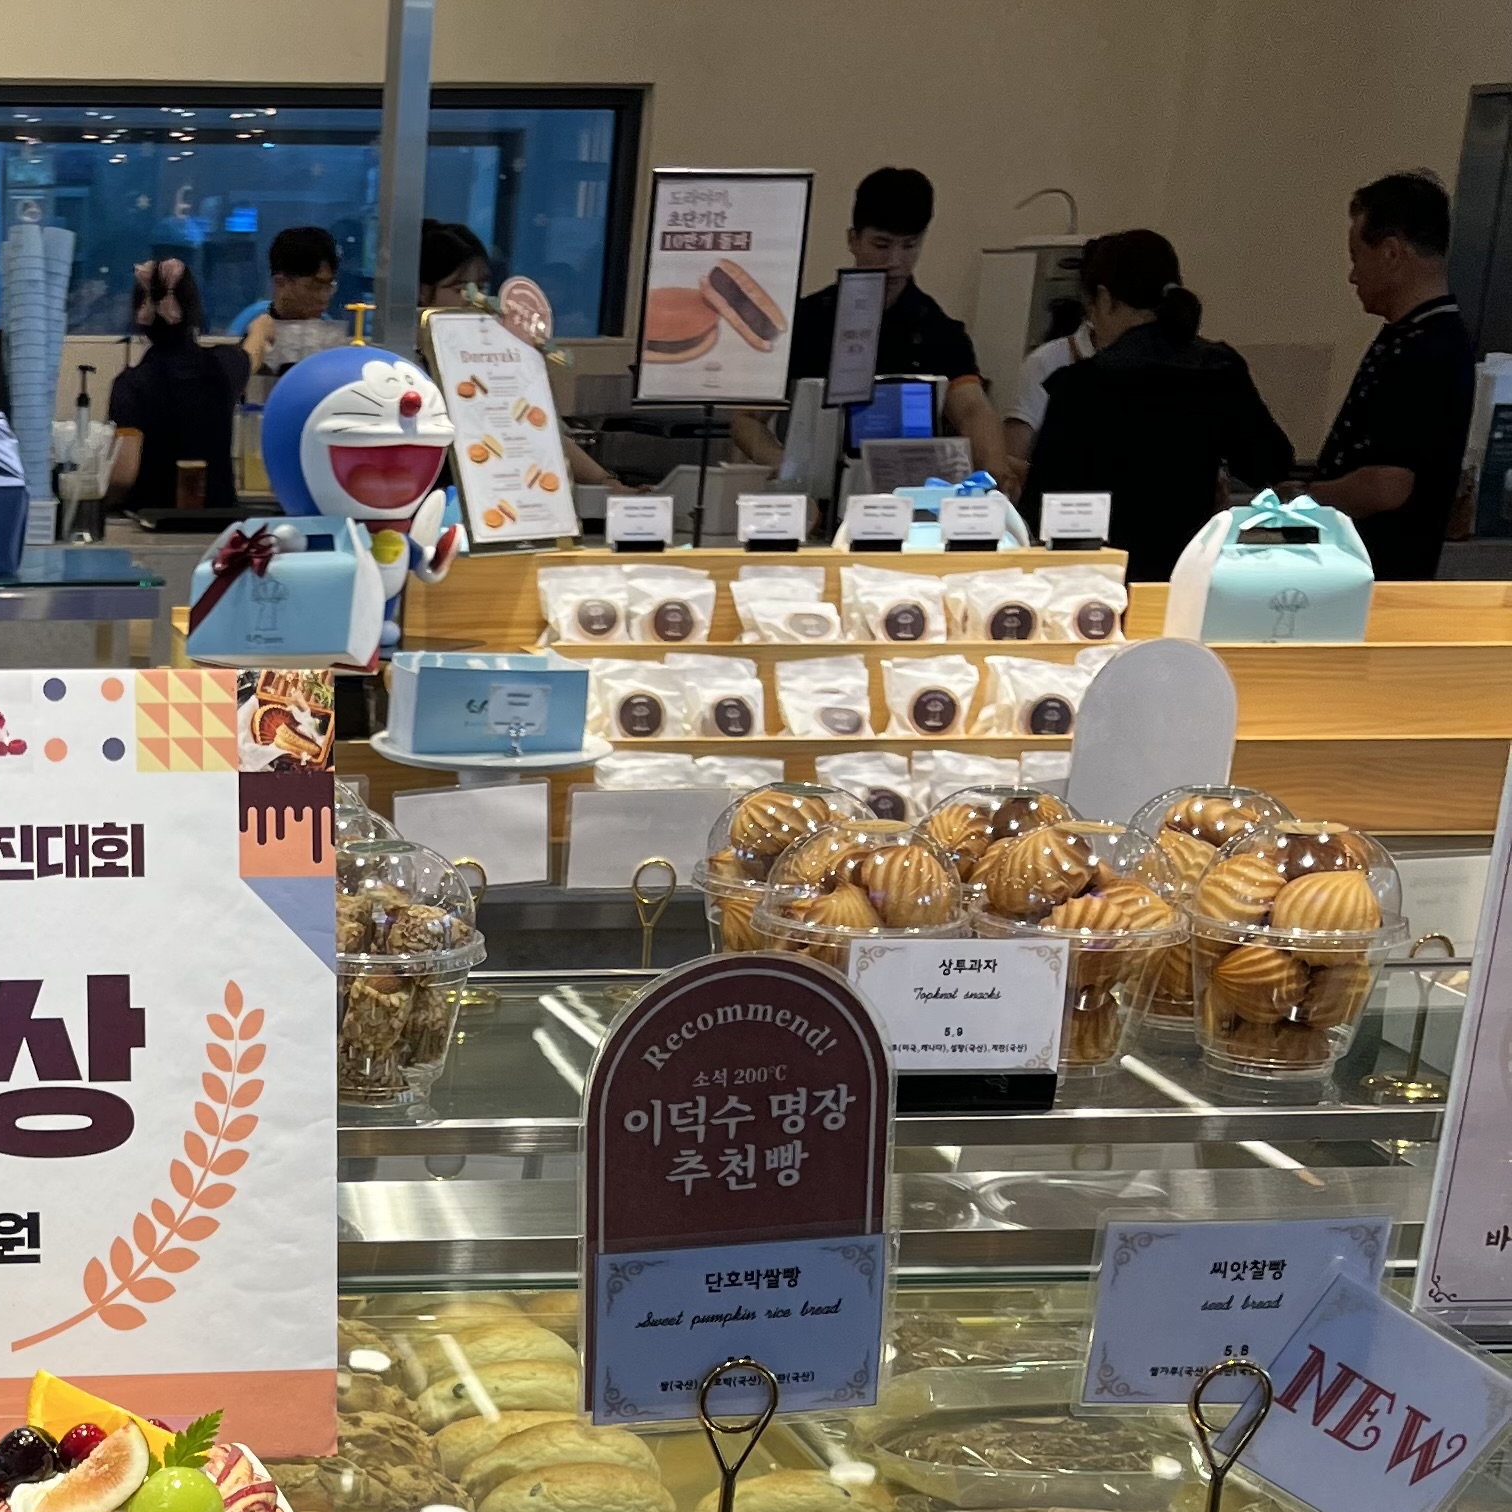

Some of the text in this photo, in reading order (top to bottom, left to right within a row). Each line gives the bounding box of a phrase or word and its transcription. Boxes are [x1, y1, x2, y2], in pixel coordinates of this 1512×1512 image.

[938, 958, 999, 976] 상투과자
[913, 987, 1002, 1004] Topknot snacks
[641, 1002, 839, 1072] Recommend!
[944, 1026, 964, 1038] 5.9
[623, 1083, 857, 1147] 이덕수 명장
[704, 1266, 802, 1293] 단호박쌀빵
[1209, 1258, 1288, 1282] 씨앗찰빵
[634, 1298, 843, 1330] Sweet pumpkin rice bread
[1201, 1293, 1284, 1311] seed bread
[1223, 1344, 1250, 1358] 5.8
[1273, 1344, 1469, 1487] NEW
